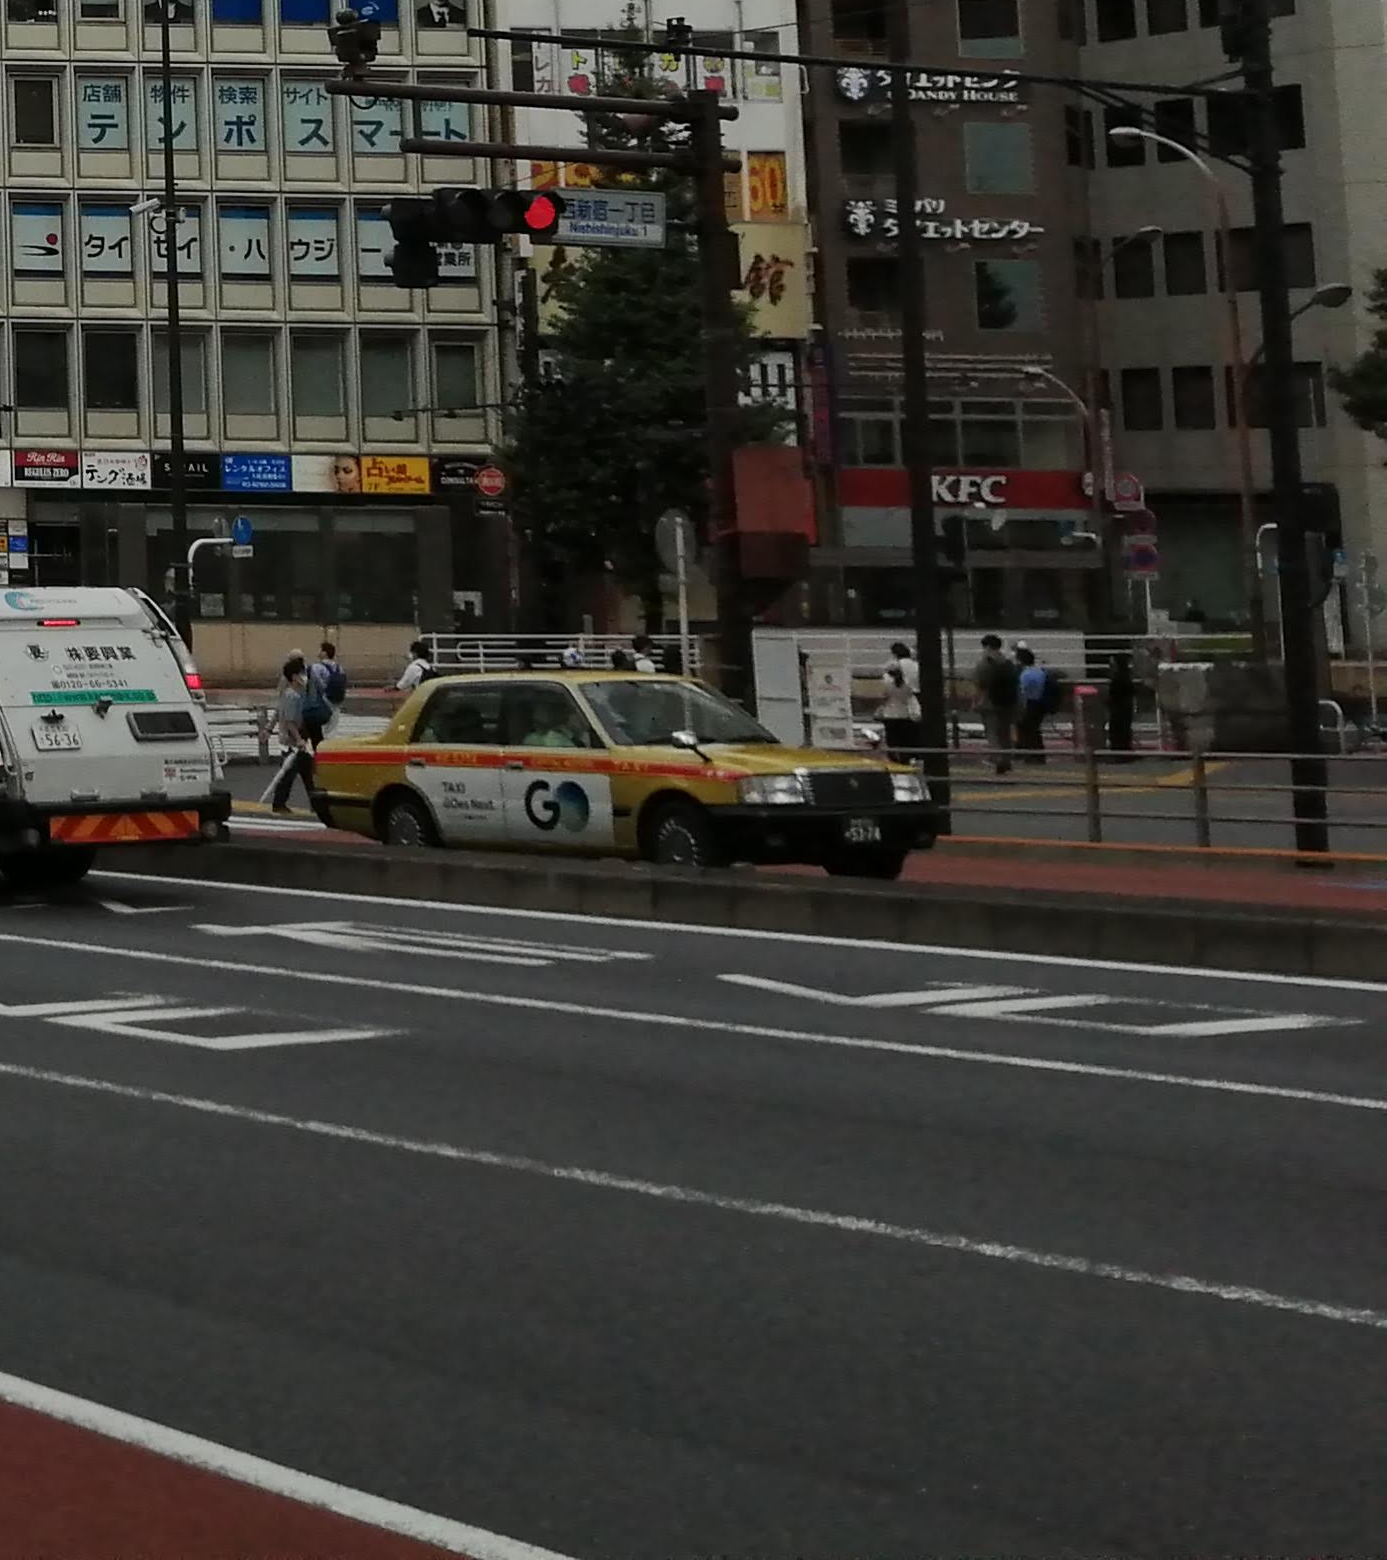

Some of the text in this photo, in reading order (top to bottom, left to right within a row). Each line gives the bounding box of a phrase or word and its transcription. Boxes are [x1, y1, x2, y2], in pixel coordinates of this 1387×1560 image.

[963, 90, 1019, 102] HOUSE
[561, 199, 656, 224] 西新宿一丁目
[930, 475, 1008, 505] KFC
